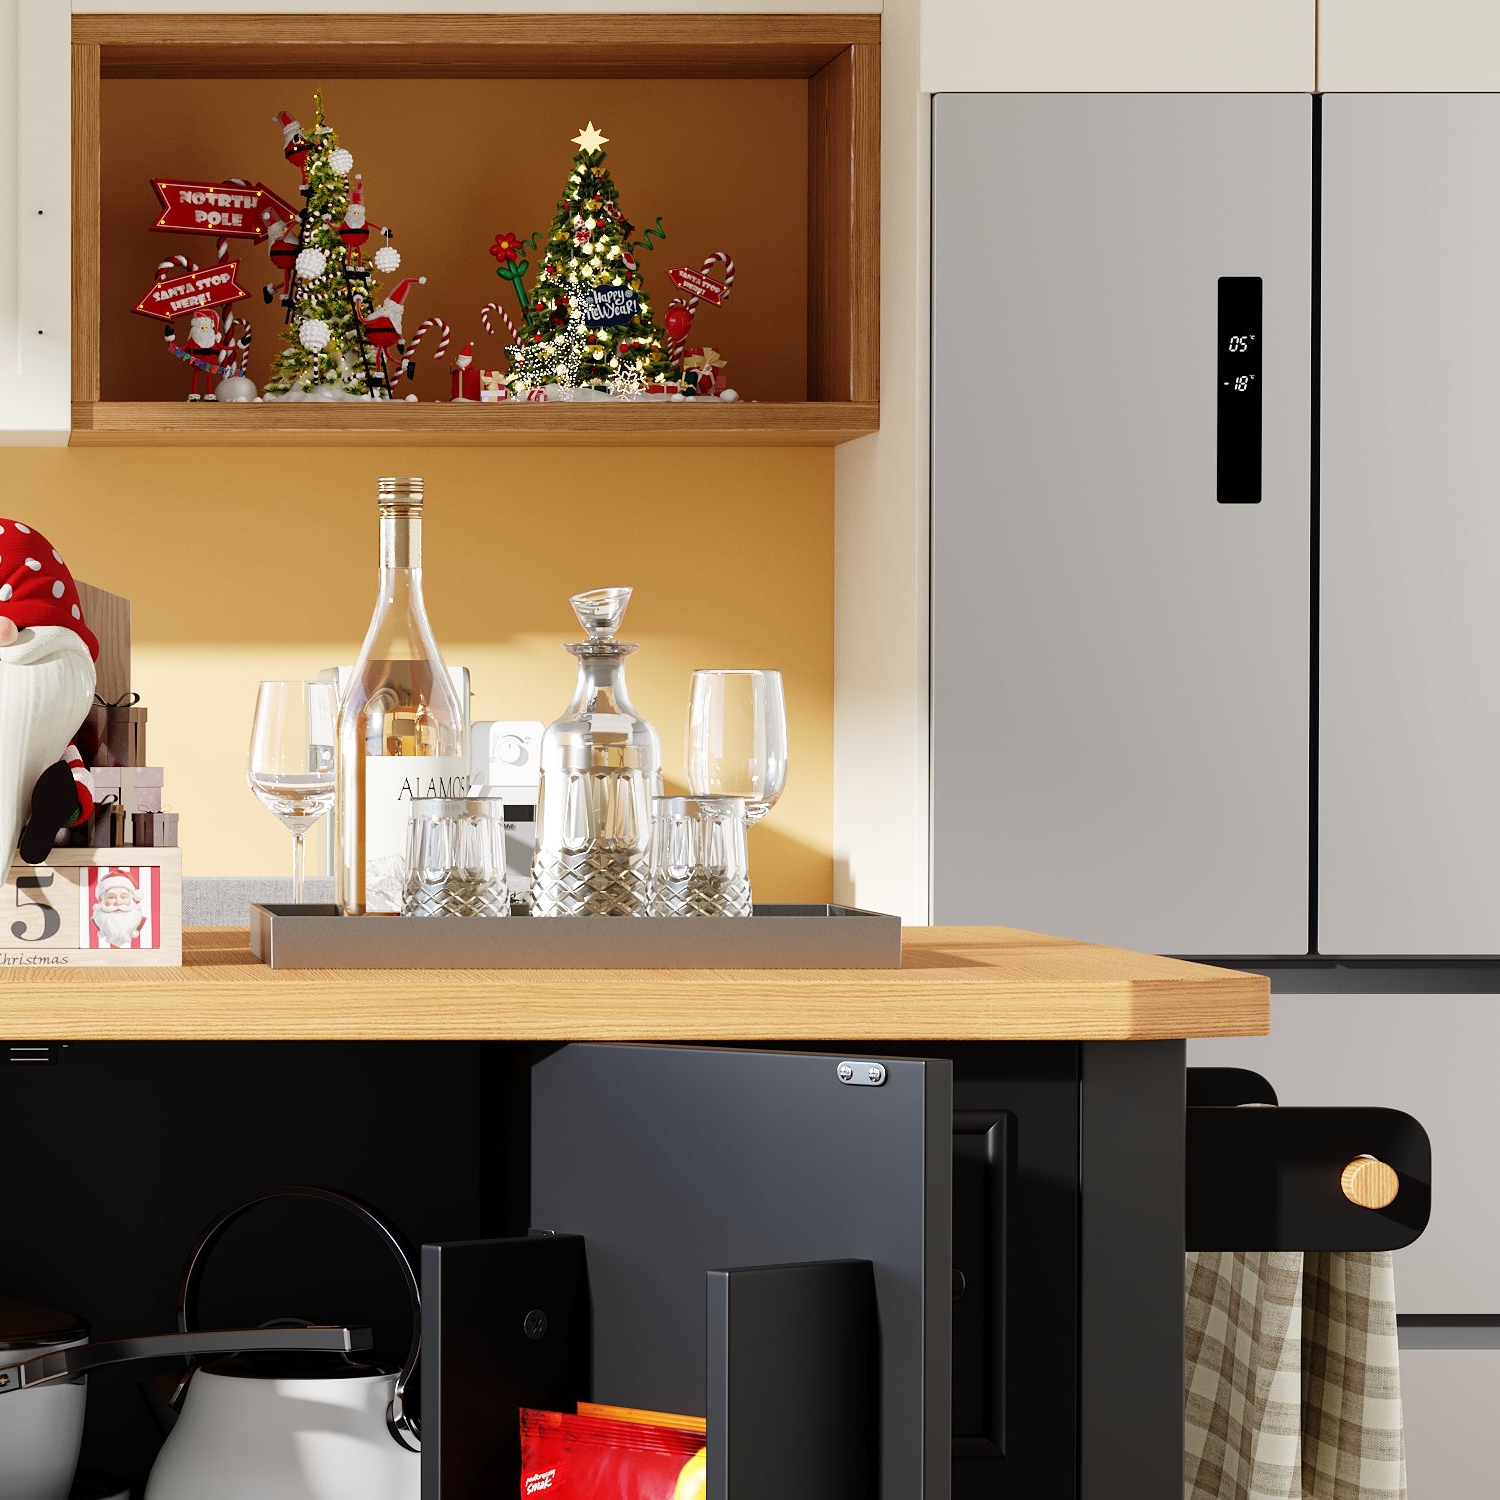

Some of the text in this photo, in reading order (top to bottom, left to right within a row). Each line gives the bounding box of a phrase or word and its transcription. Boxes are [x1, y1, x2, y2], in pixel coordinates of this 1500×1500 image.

[194, 210, 243, 227] POLE
[152, 273, 231, 302] SANTA STOP
